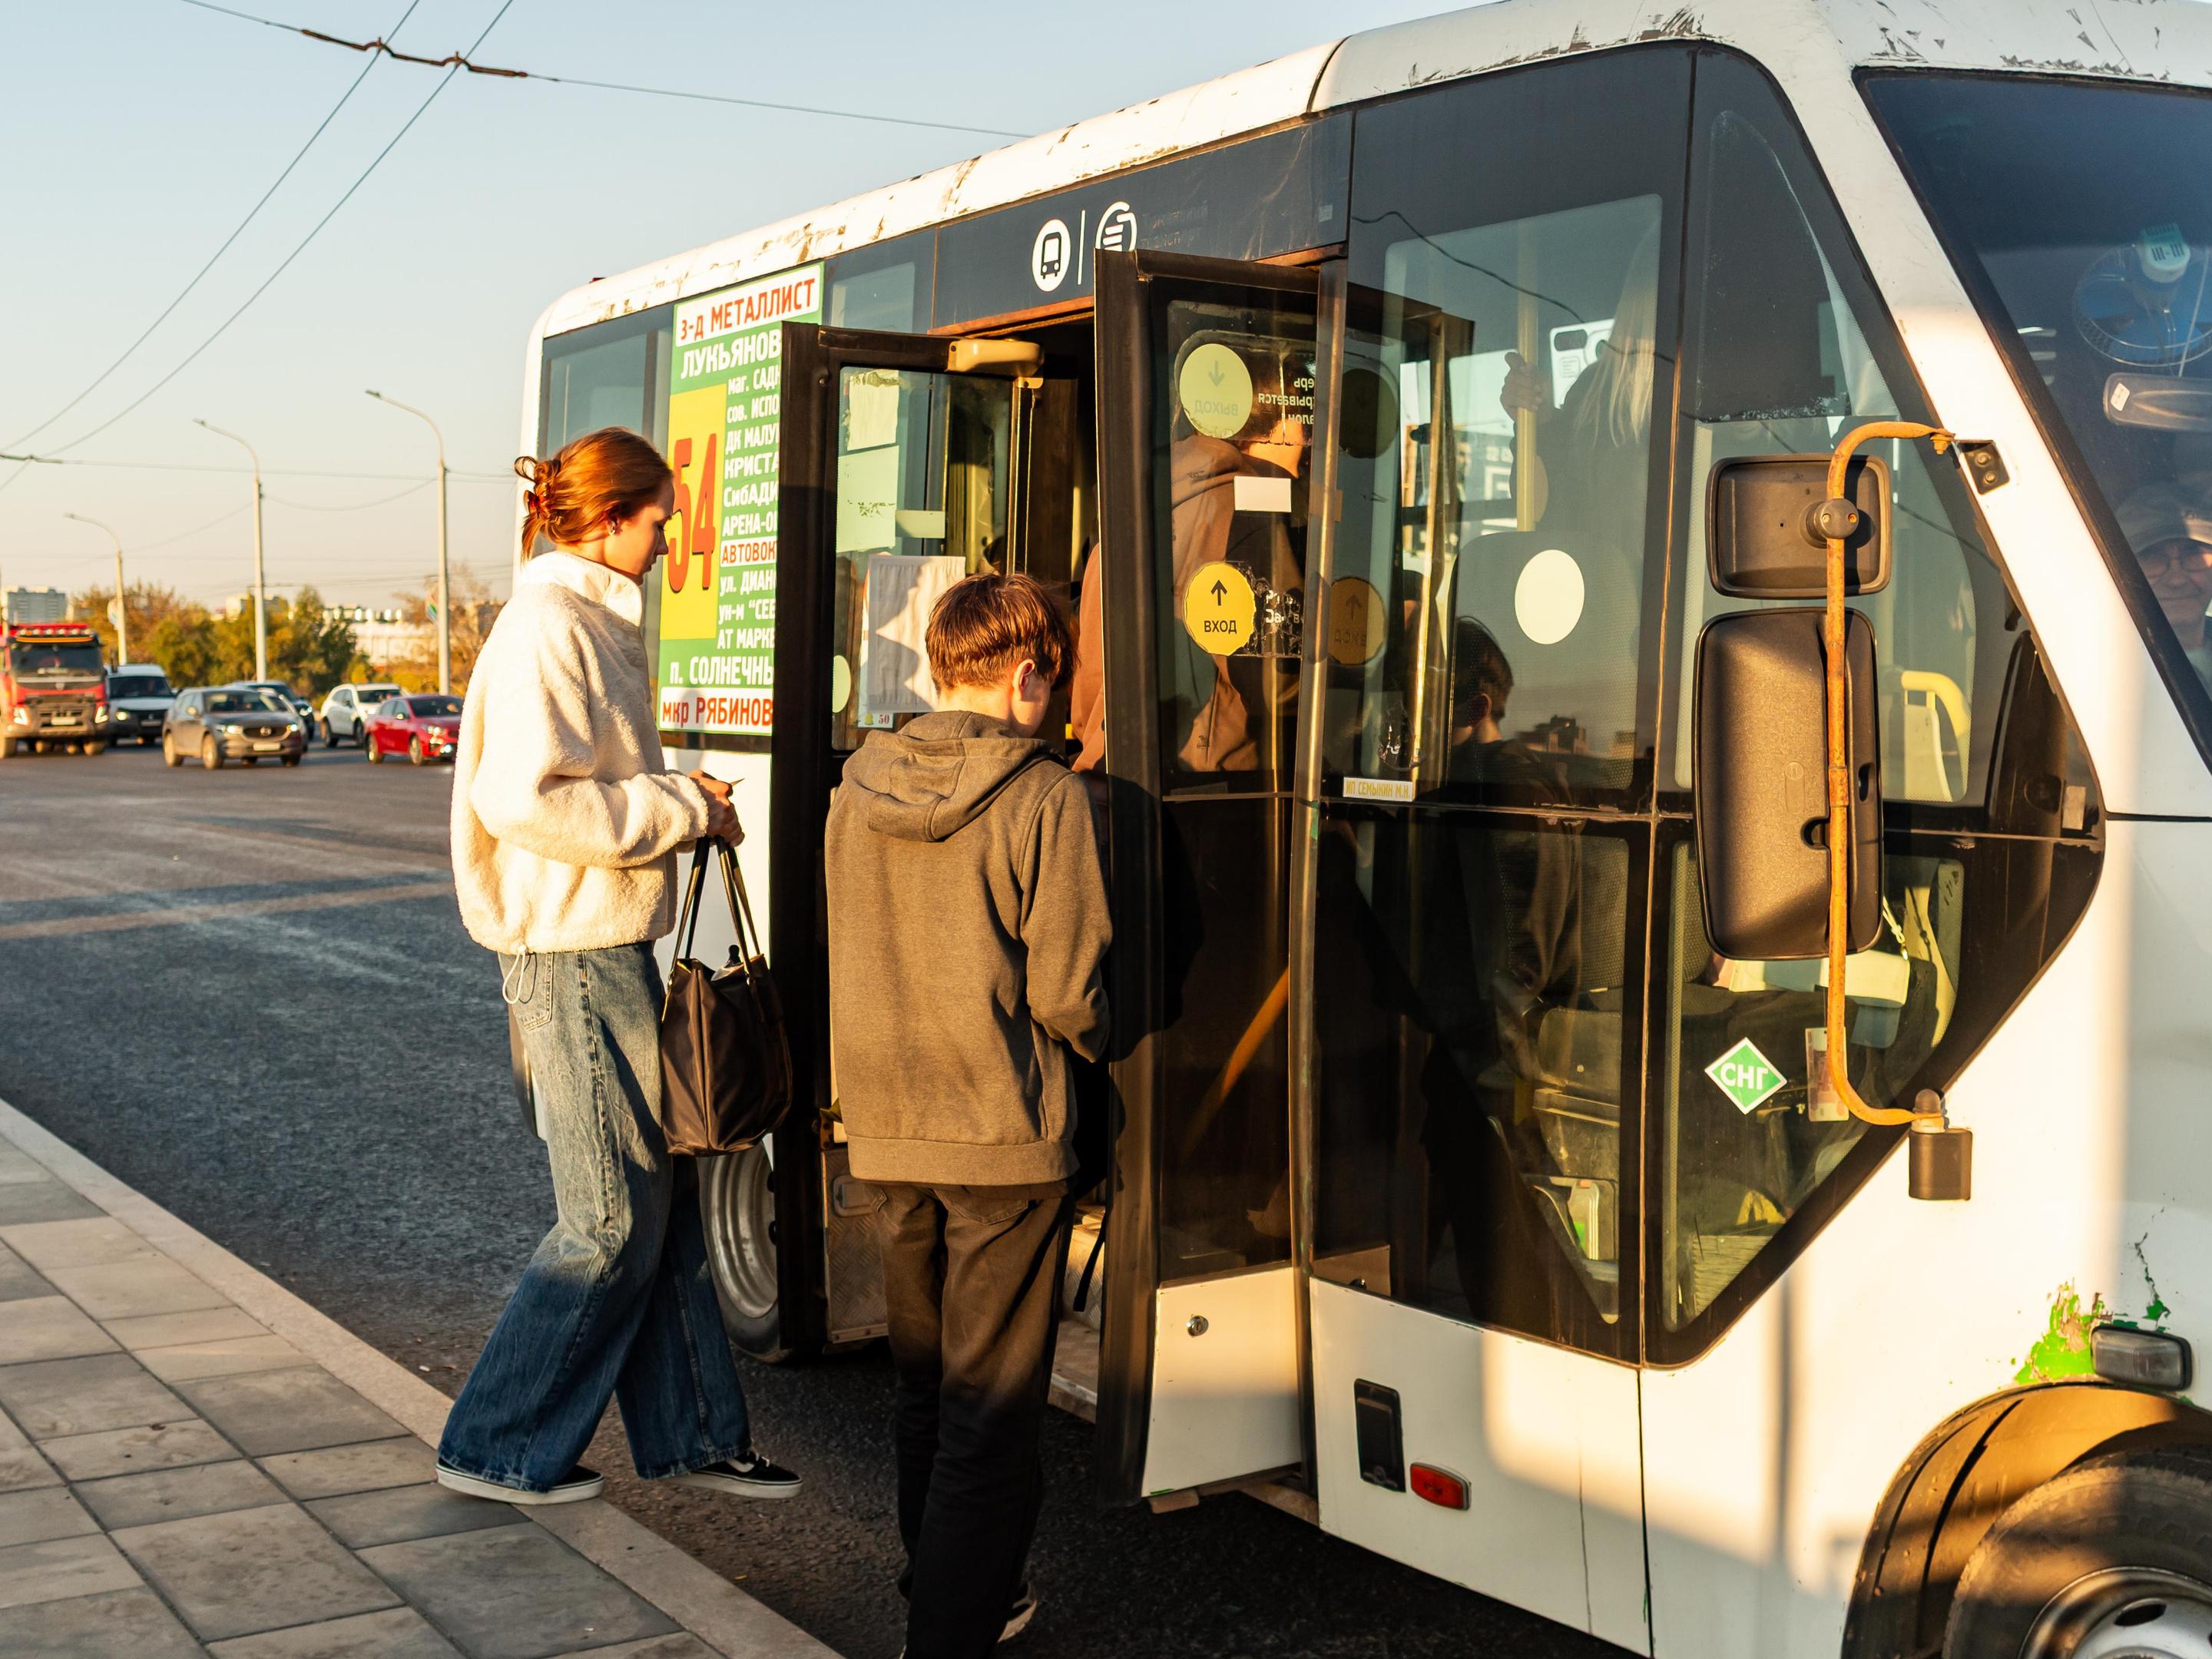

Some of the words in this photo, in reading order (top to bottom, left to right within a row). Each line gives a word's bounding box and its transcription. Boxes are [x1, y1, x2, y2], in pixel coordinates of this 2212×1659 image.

[711, 278, 815, 333] МЕТАЛЛИСТ
[728, 376, 750, 396] маг.
[725, 429, 742, 455] ДК
[667, 432, 717, 593] 54
[719, 575, 737, 597] ул.
[740, 569, 777, 595] ДИАН
[717, 628, 734, 650] АТ
[1204, 619, 1237, 634] ВХОД
[669, 662, 684, 684] п.
[662, 700, 690, 728] мкр
[696, 697, 773, 727] РЯБИНОВ
[1720, 1062, 1769, 1091] СНГ
